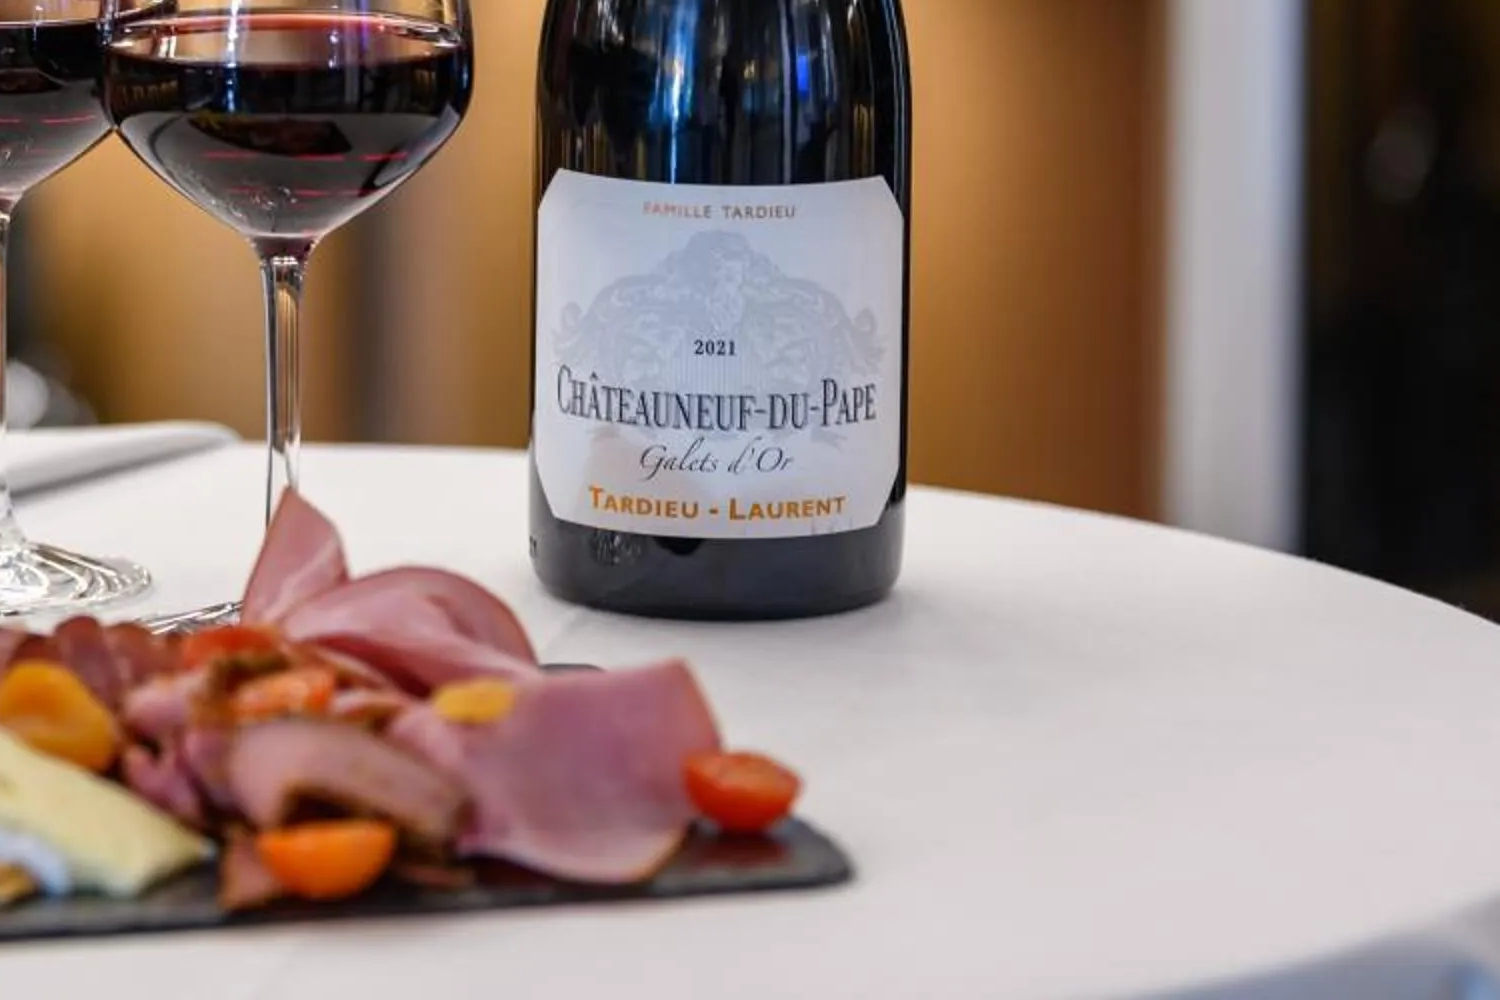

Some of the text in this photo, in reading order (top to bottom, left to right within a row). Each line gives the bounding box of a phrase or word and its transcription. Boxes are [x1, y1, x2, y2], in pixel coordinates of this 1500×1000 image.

[642, 200, 797, 220] FAMILLE TARDIEU
[693, 339, 737, 356] 2021
[556, 364, 877, 431] CHÂTEAUNEUF-DU-PAPE
[638, 436, 794, 481] Galets d'Or
[589, 485, 699, 520] TARDIEU
[729, 495, 846, 521] LAURENT
